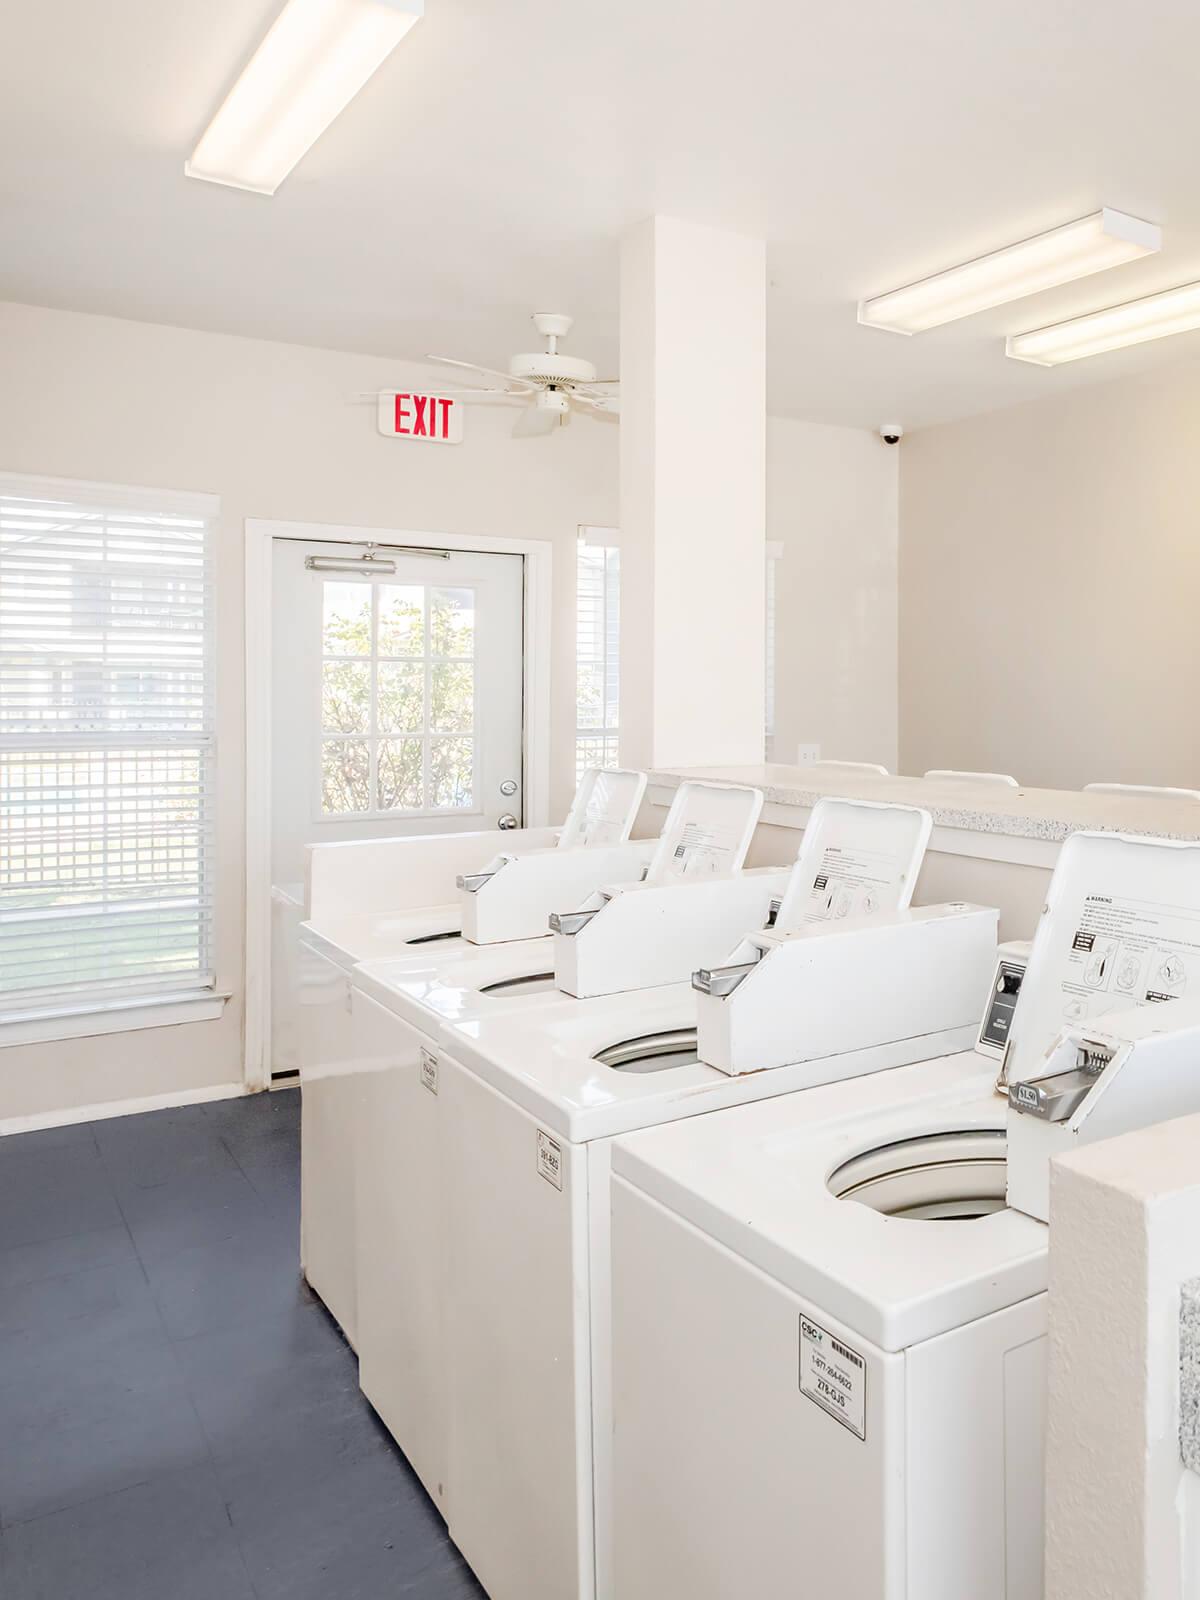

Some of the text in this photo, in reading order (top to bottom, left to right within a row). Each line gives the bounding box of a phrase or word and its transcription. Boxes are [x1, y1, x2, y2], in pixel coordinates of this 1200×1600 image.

[395, 393, 453, 439] EXIT
[1020, 1088, 1036, 1102] $1.50
[801, 1321, 818, 1338] CSC
[817, 1378, 845, 1407] 278-GJS
